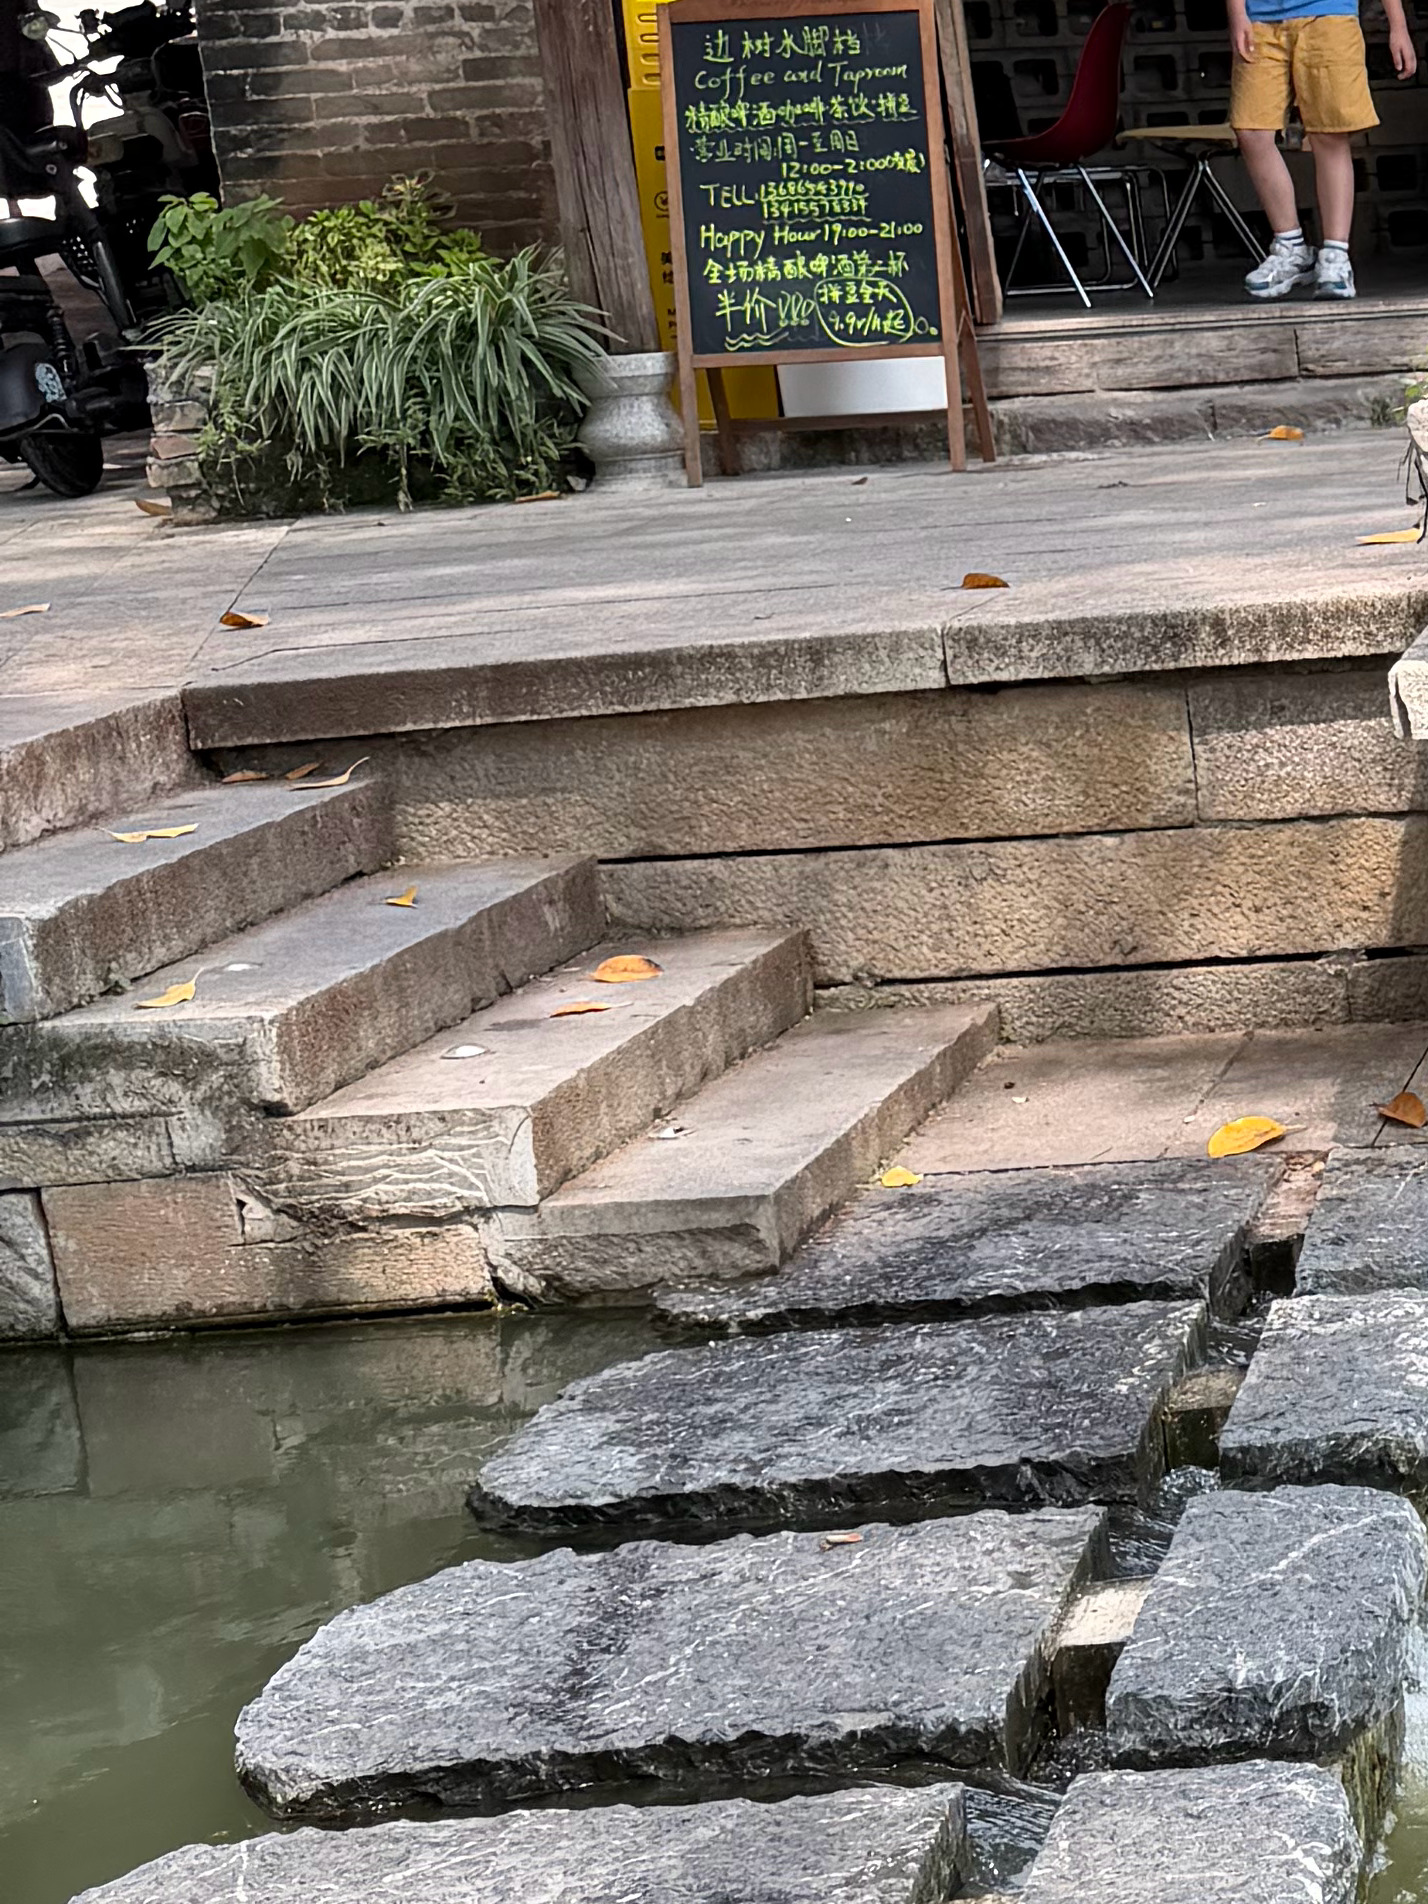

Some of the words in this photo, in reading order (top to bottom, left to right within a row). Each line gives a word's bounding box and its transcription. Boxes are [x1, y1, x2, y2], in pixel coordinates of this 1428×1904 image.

[703, 25, 861, 63] 边树水脚档
[694, 64, 775, 99] Coffee
[783, 60, 822, 83] and
[700, 223, 765, 260] Happy
[773, 226, 822, 246] Hour
